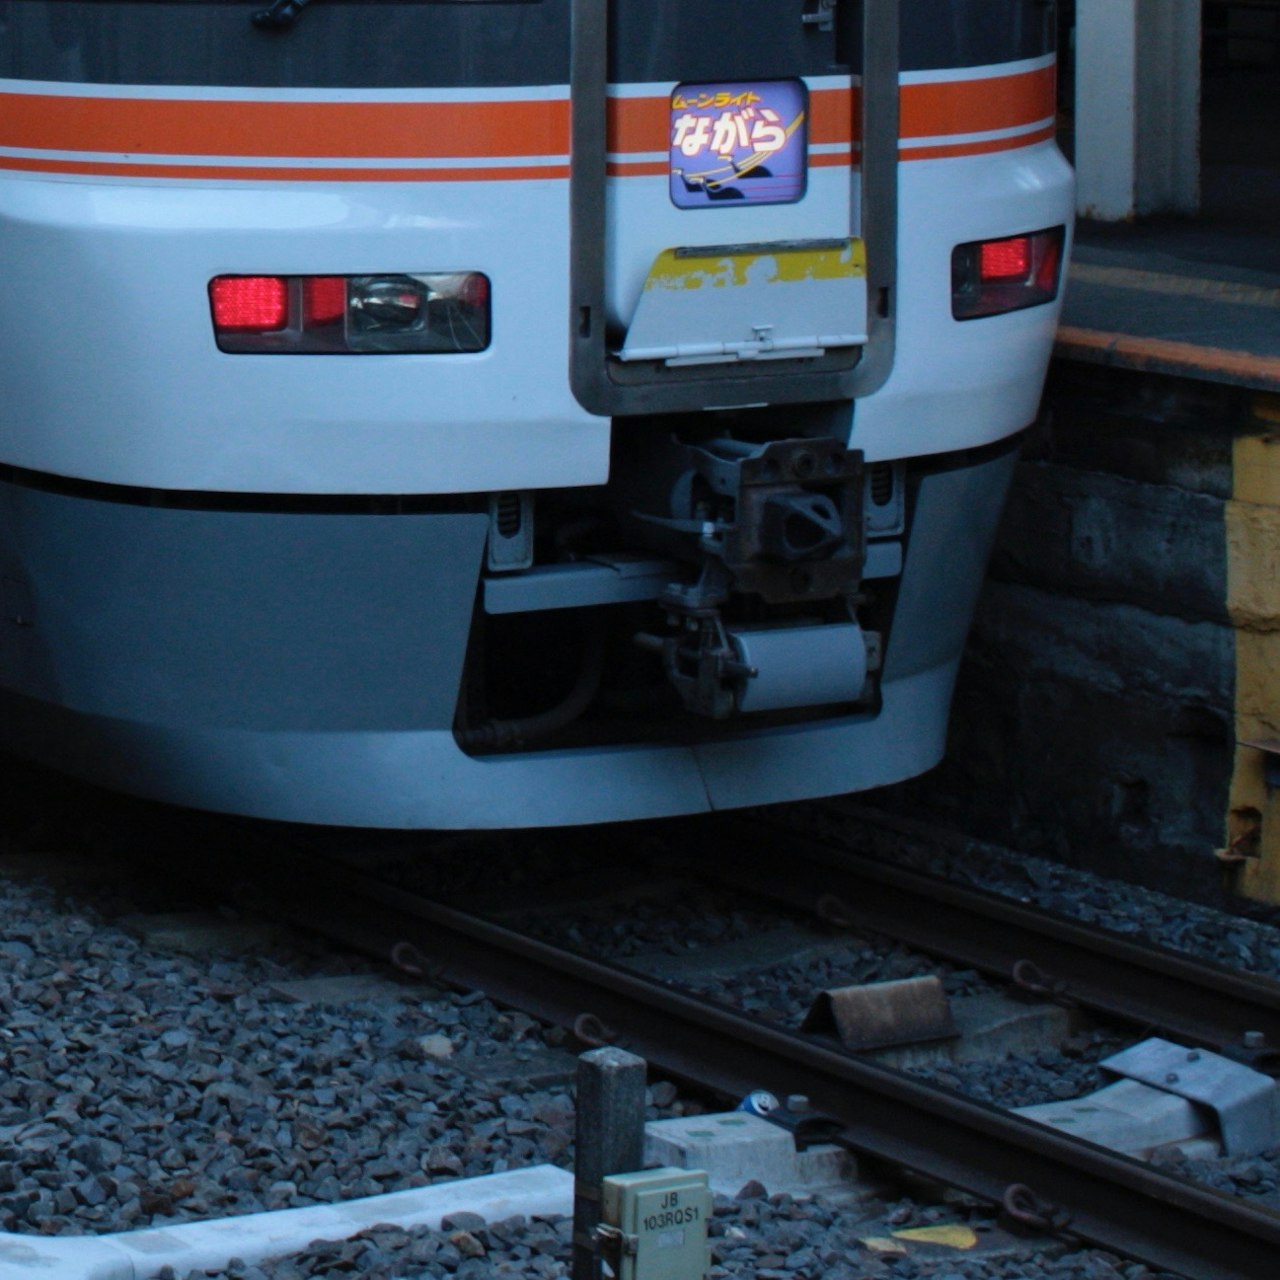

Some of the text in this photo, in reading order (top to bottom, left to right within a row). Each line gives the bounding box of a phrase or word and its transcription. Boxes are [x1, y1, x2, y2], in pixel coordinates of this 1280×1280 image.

[671, 90, 762, 110] ムーンライト
[673, 107, 786, 157] ながら
[661, 1192, 679, 1209] JB
